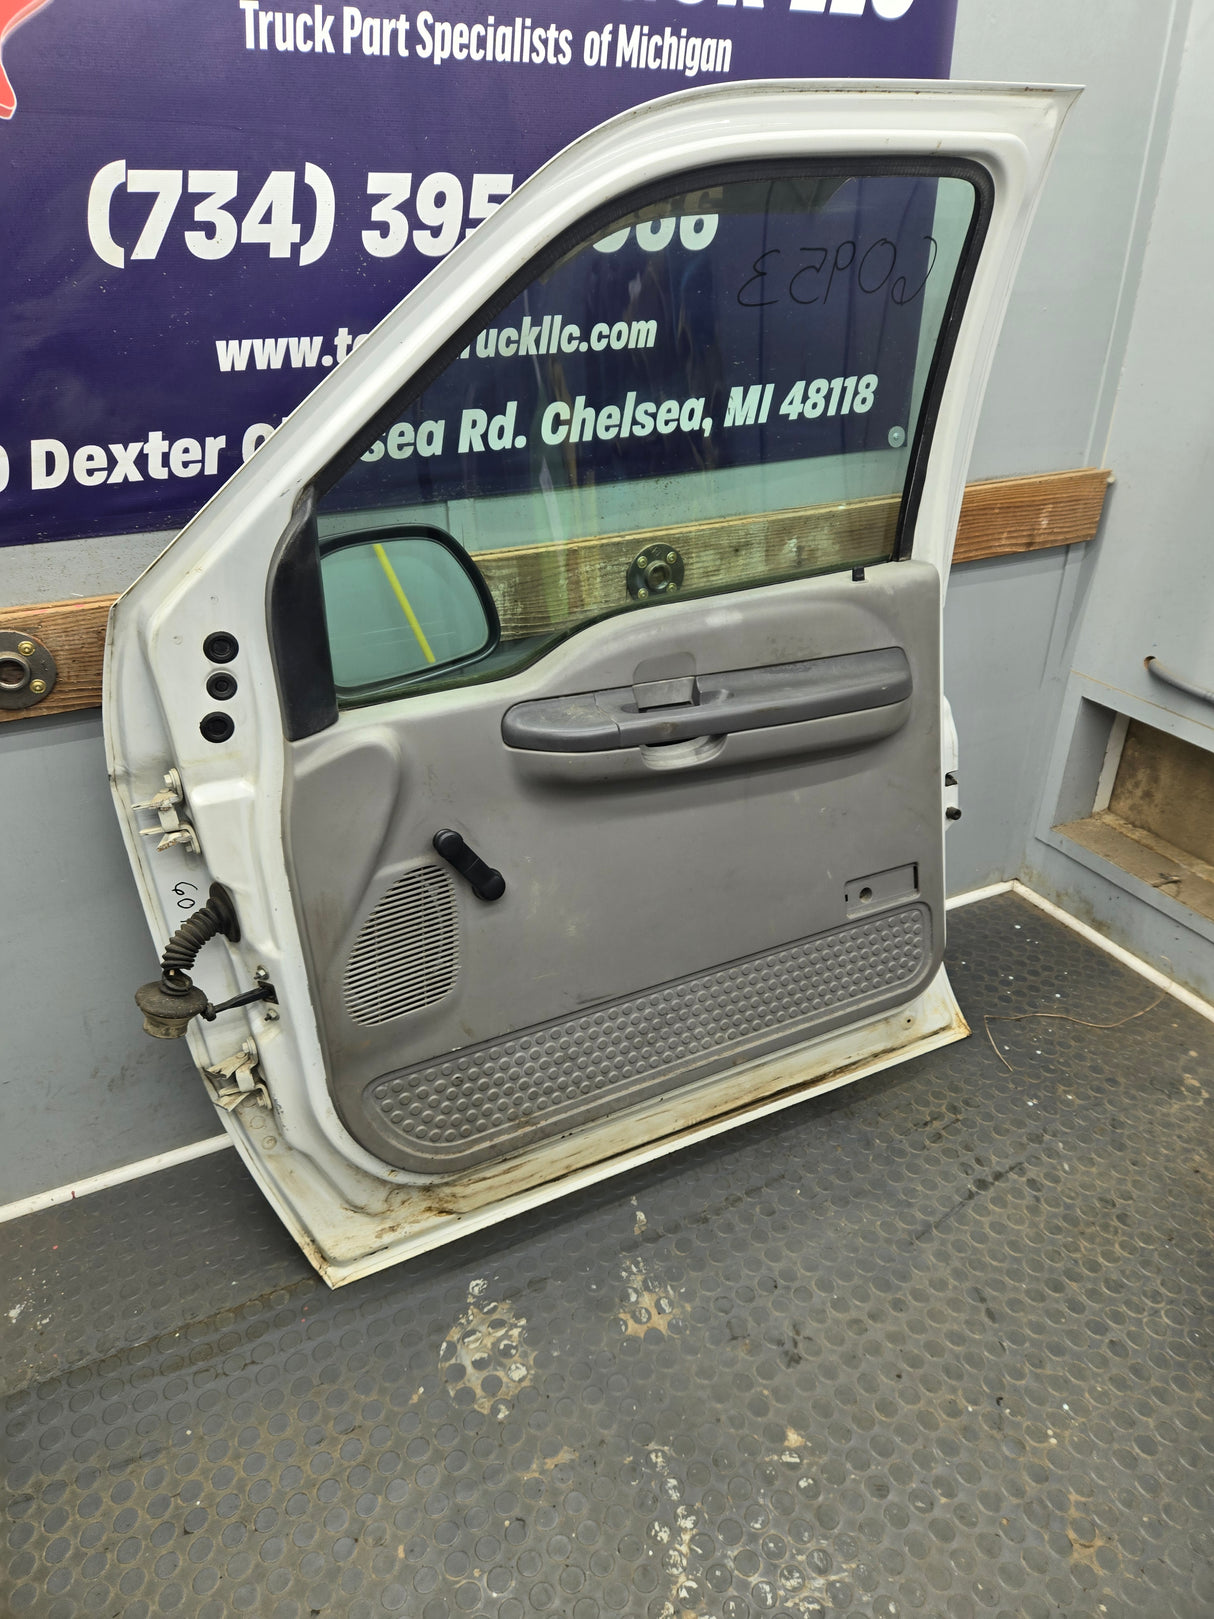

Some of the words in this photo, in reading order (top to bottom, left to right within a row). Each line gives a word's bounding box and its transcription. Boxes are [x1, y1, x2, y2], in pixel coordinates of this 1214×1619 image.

[239, 0, 336, 54] Truck
[343, 6, 410, 57] Part
[415, 10, 573, 65] Specialists
[583, 25, 613, 67] of
[615, 23, 733, 77] Michigan
[87, 159, 336, 269] (734)
[31, 431, 226, 490] Dexter
[458, 401, 527, 453] Rd.
[541, 391, 713, 445] Chelsea,
[723, 383, 775, 428] MI
[779, 373, 878, 420] 48118
